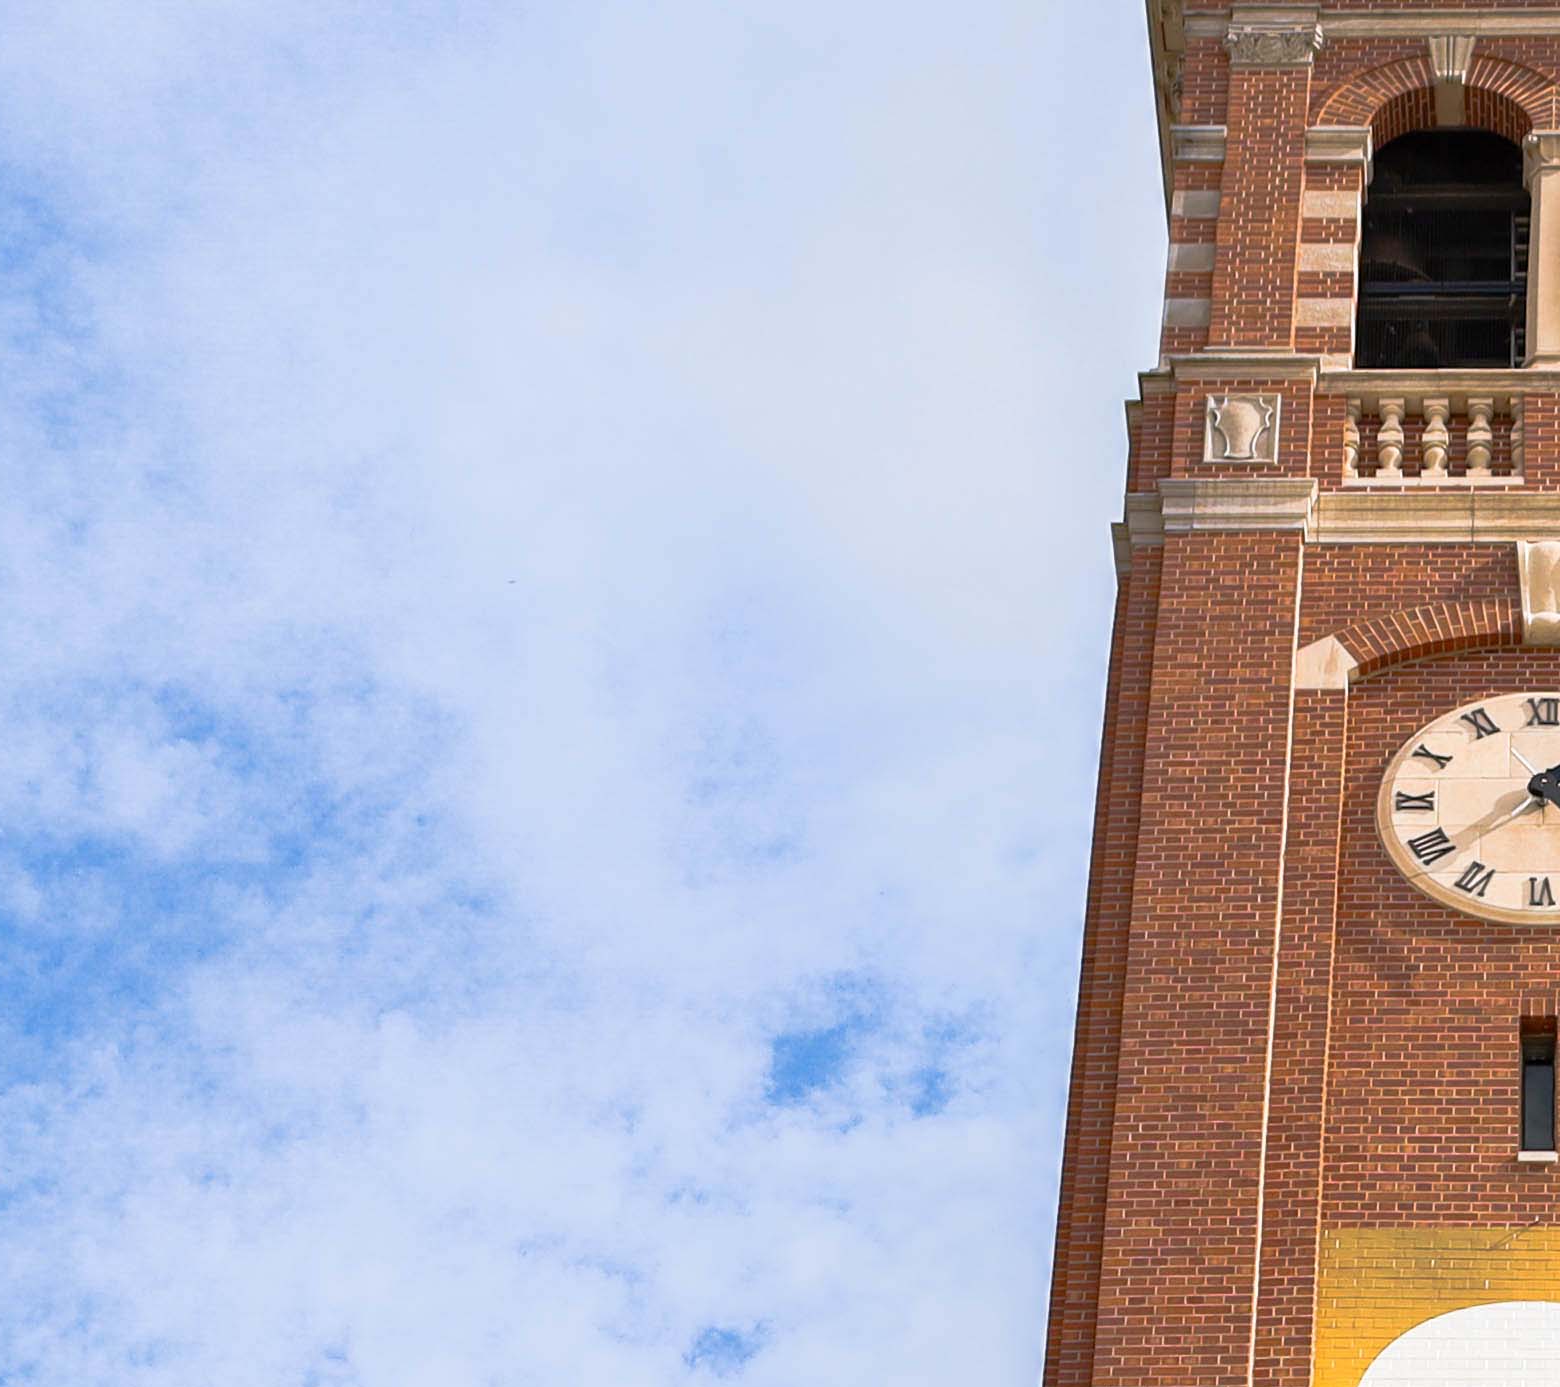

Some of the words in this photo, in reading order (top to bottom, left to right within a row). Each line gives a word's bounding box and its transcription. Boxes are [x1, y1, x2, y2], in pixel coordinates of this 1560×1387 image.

[1461, 708, 1501, 739] XI
[1527, 698, 1560, 726] XII
[1412, 744, 1453, 769] X
[1396, 791, 1435, 811] IX
[1407, 827, 1456, 865] VIII
[1455, 862, 1496, 897] VII
[1529, 877, 1556, 906] VI
